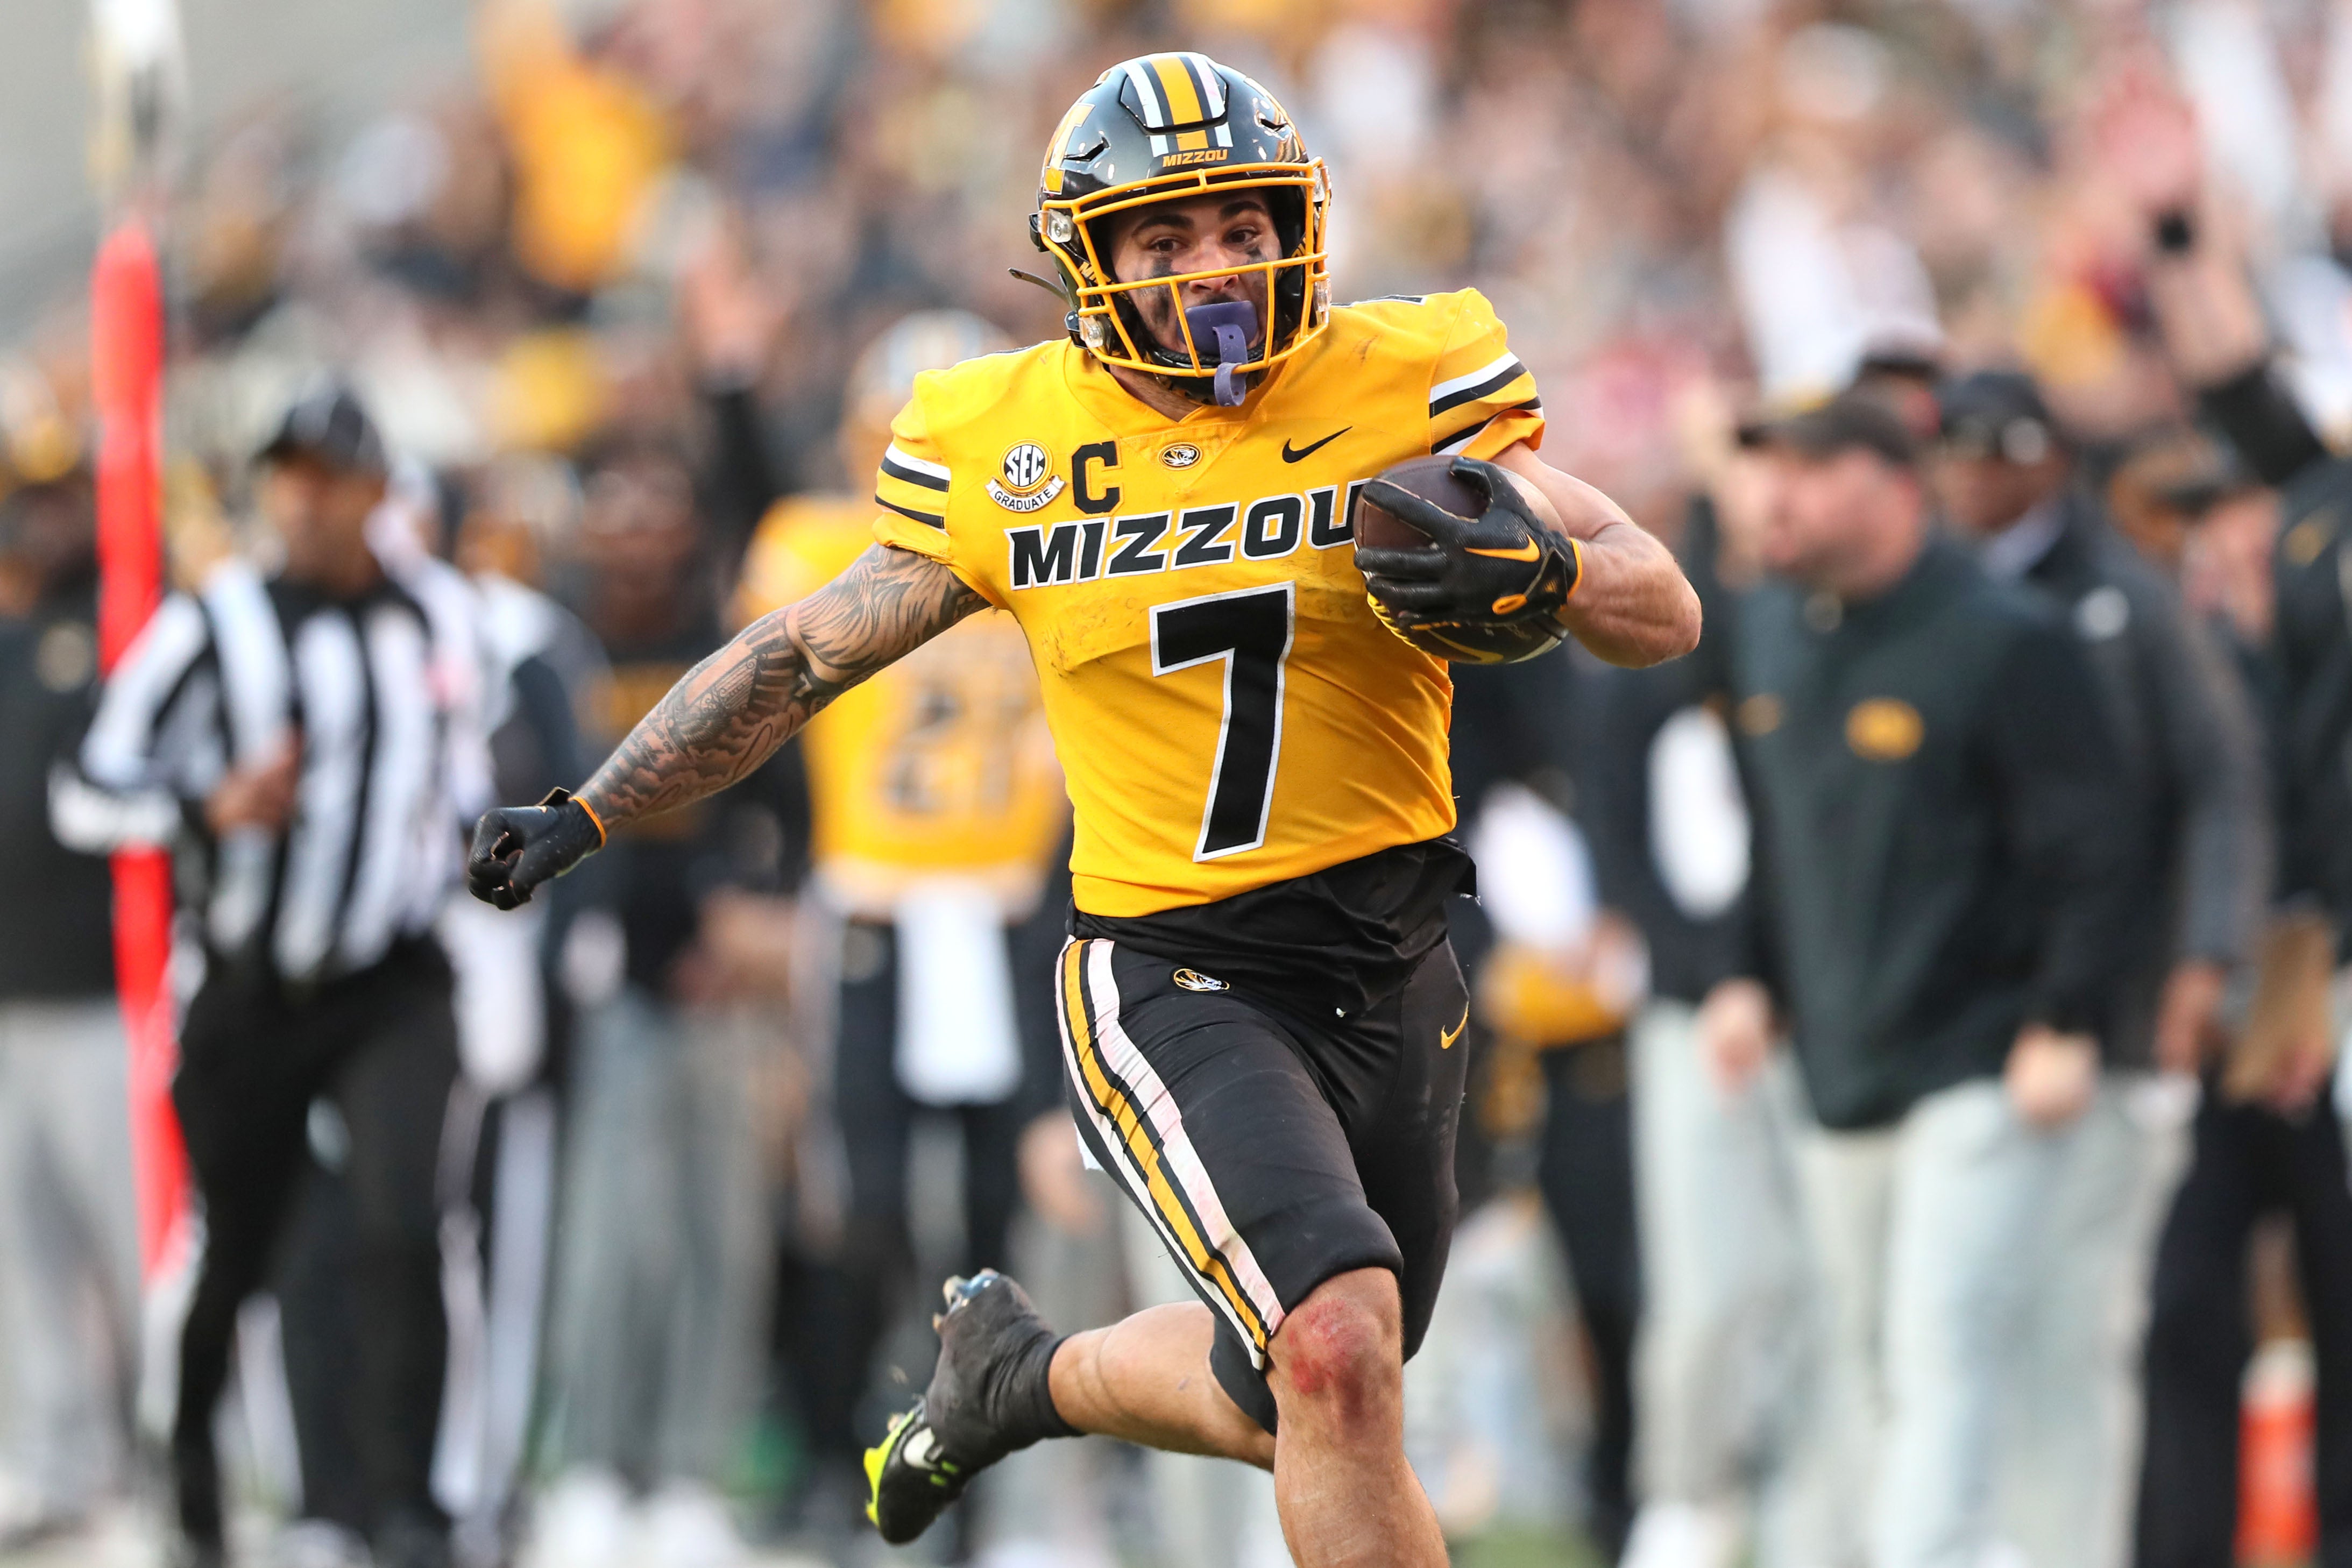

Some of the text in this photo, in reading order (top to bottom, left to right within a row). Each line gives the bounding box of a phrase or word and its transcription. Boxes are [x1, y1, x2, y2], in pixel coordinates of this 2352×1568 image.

[1162, 148, 1228, 167] MIZZOU
[1004, 444, 1046, 487] SEC
[1071, 440, 1120, 514] C
[994, 489, 1054, 510] GRADUATE
[1004, 478, 1372, 591] MIZZOU
[1149, 580, 1295, 863] 7
